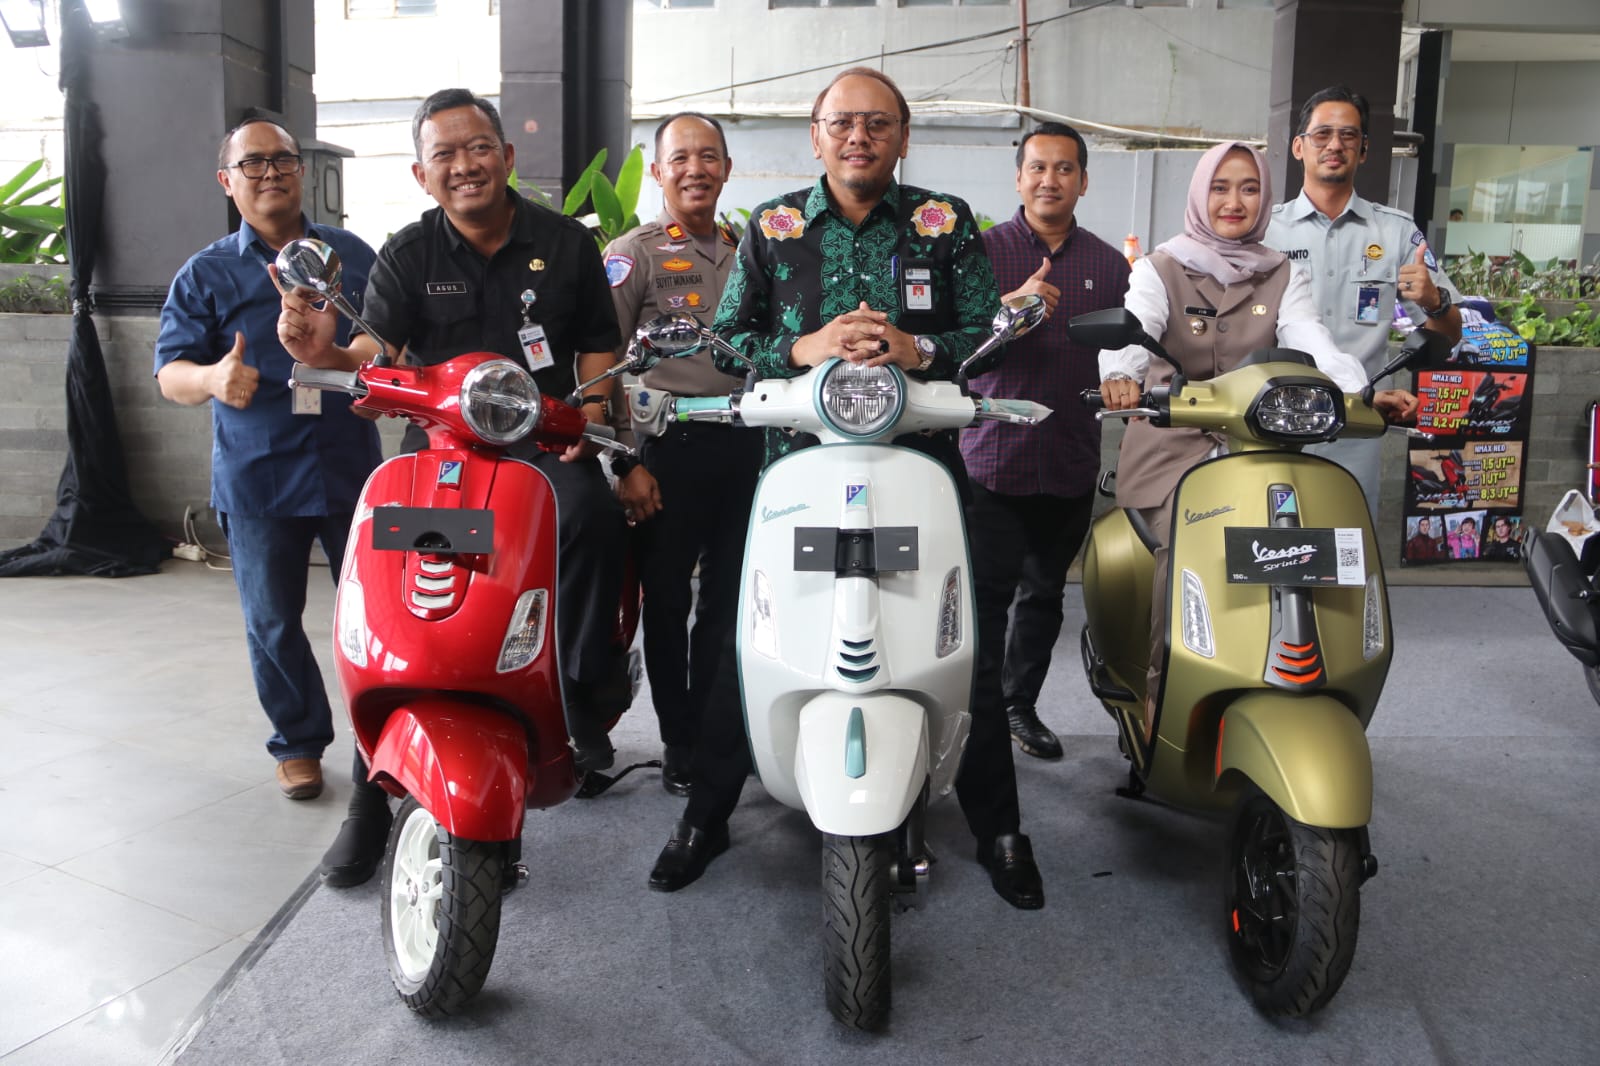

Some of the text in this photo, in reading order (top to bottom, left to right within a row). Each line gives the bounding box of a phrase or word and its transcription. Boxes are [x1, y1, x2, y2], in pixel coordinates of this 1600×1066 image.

[1438, 387, 1450, 400] 1,5
[1482, 458, 1494, 471] 1,5
[761, 503, 811, 524] Vespa
[1184, 505, 1237, 526] Vespa
[1251, 540, 1318, 563] Vespa
[1262, 559, 1298, 572] Sprint
